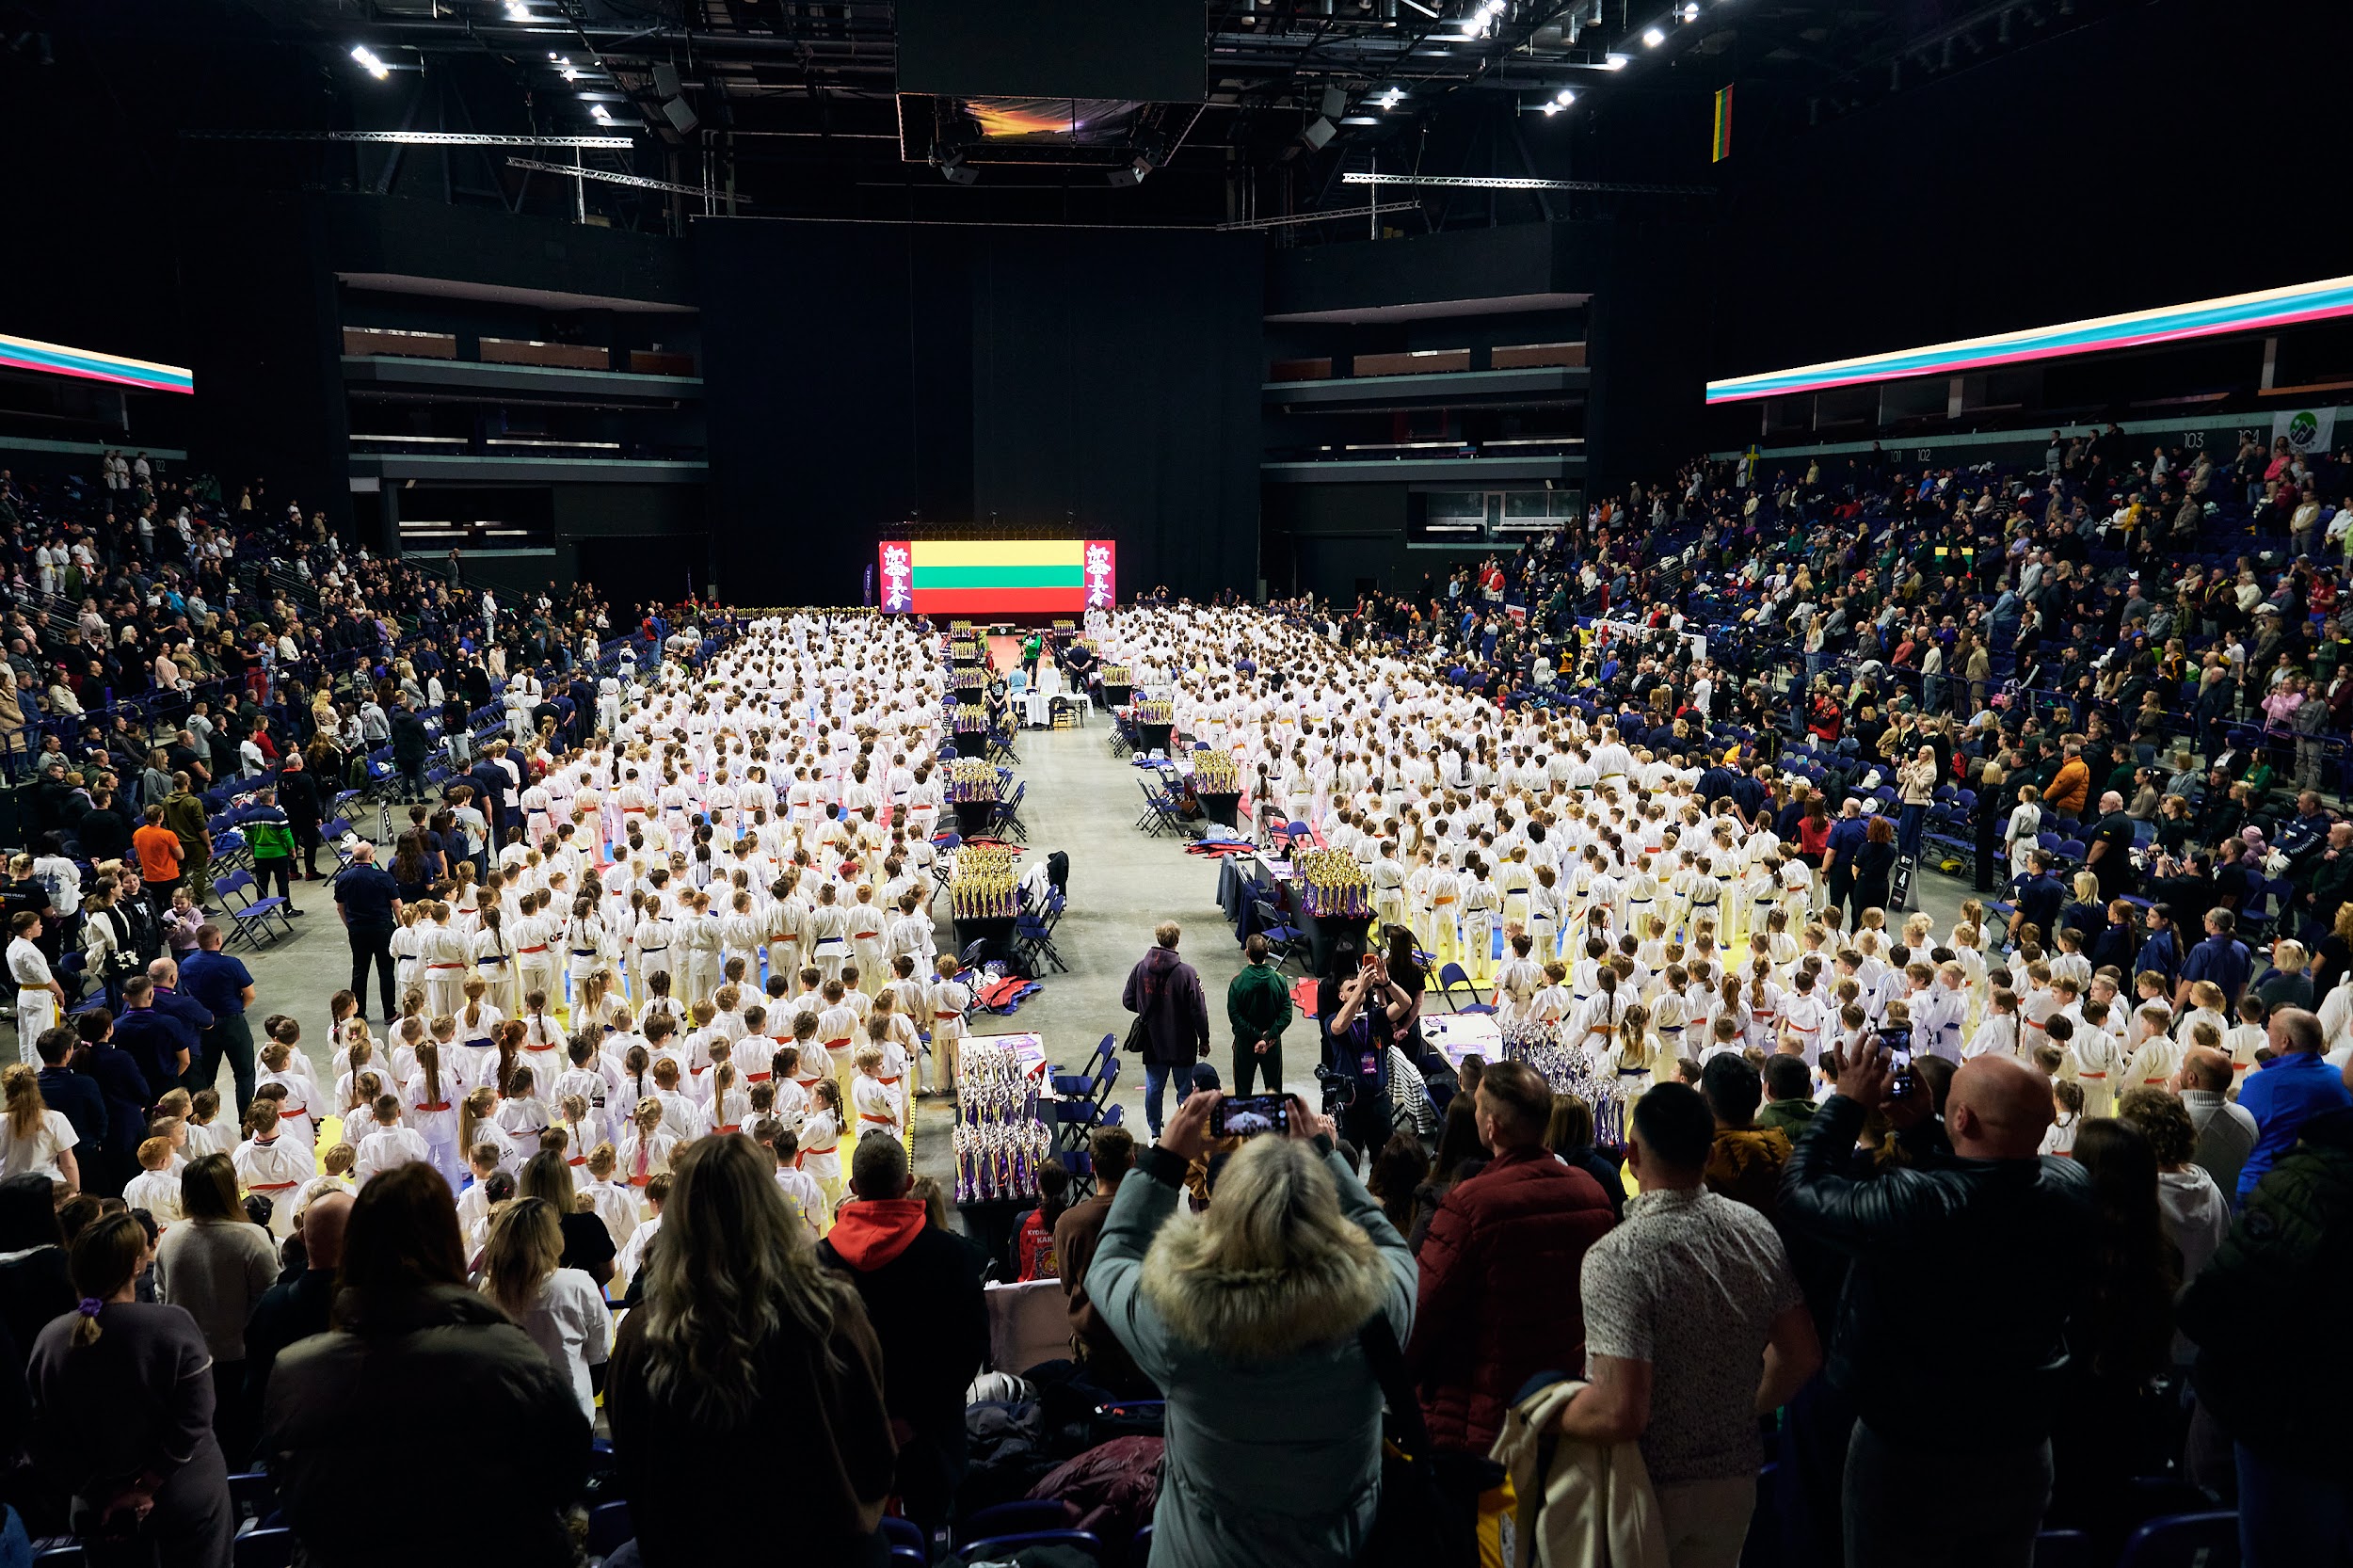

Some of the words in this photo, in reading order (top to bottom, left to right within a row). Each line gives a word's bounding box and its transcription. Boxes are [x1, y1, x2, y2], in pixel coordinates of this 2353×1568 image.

[2184, 431, 2204, 449] 103
[1890, 450, 1902, 463] 101
[1917, 448, 1930, 462] 102
[1897, 871, 1907, 888] 4
[1036, 1236, 1053, 1244] KAR
